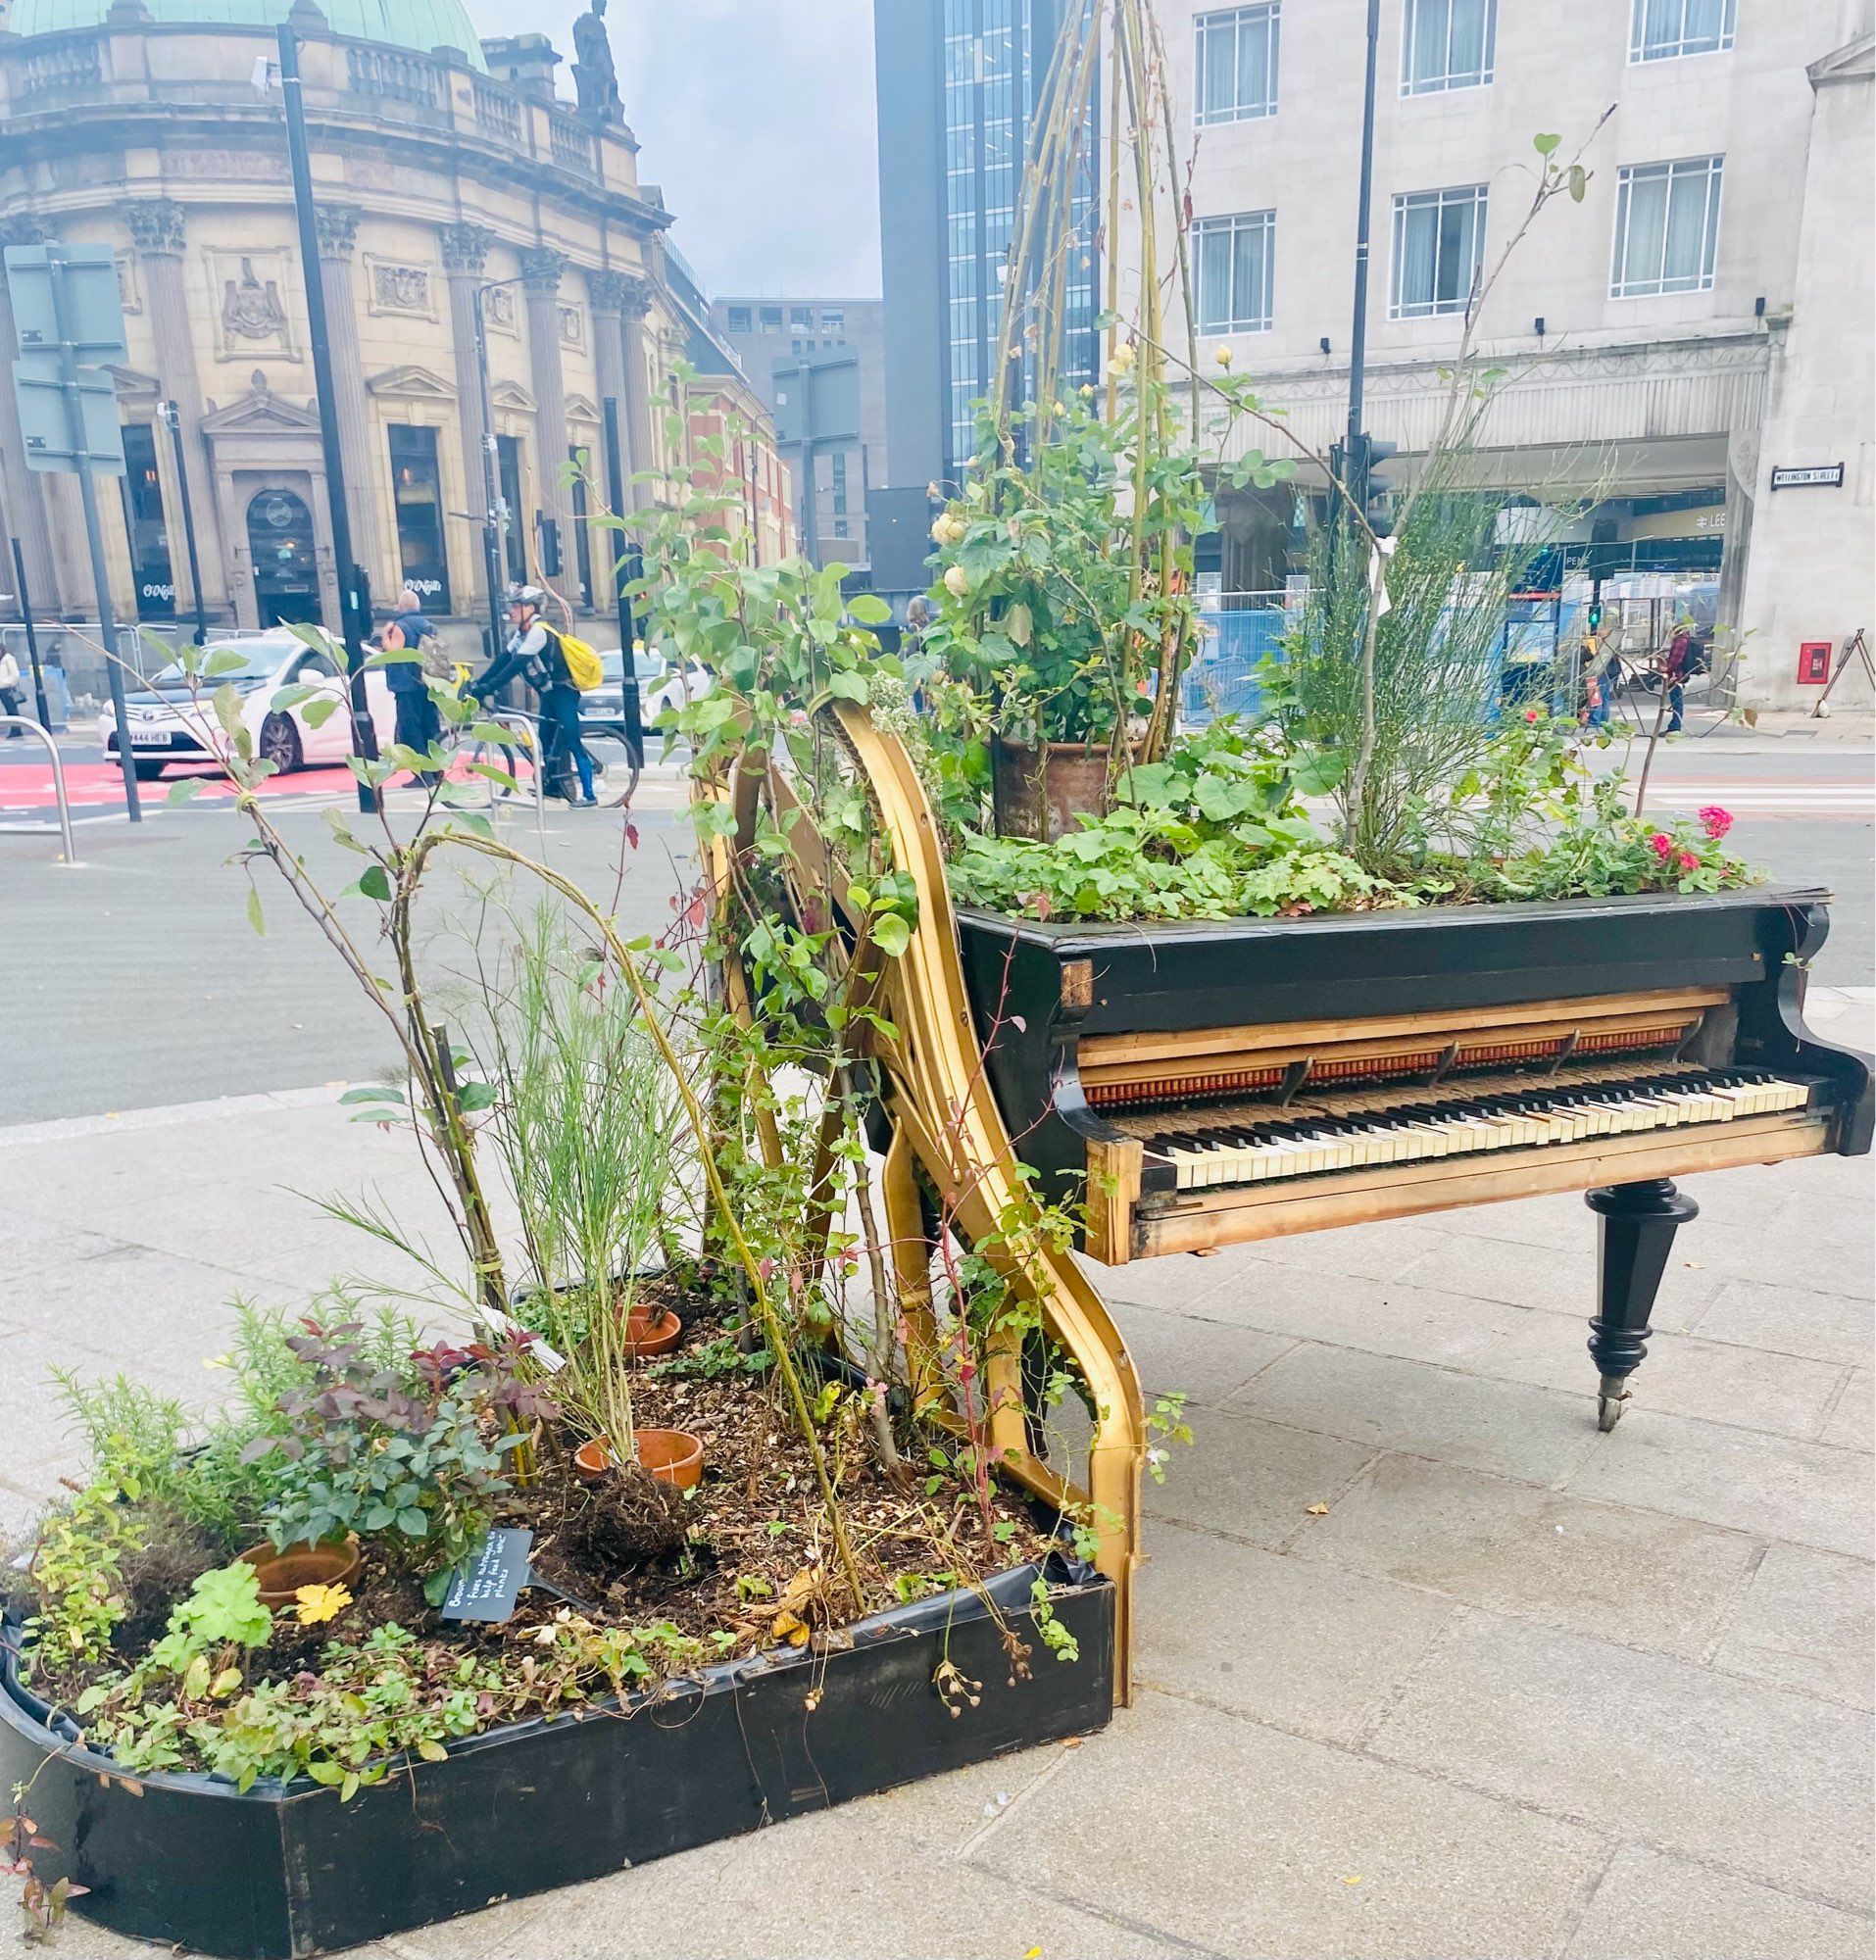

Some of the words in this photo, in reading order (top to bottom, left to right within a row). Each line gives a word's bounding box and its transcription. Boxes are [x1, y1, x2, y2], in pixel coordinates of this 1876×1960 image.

[1776, 471, 1811, 482] WELLINGTON
[1812, 470, 1835, 480] STREET
[488, 1558, 501, 1576] feed
[448, 1578, 466, 1607] Broom
[479, 1579, 498, 1598] help
[494, 1568, 510, 1598] plants
